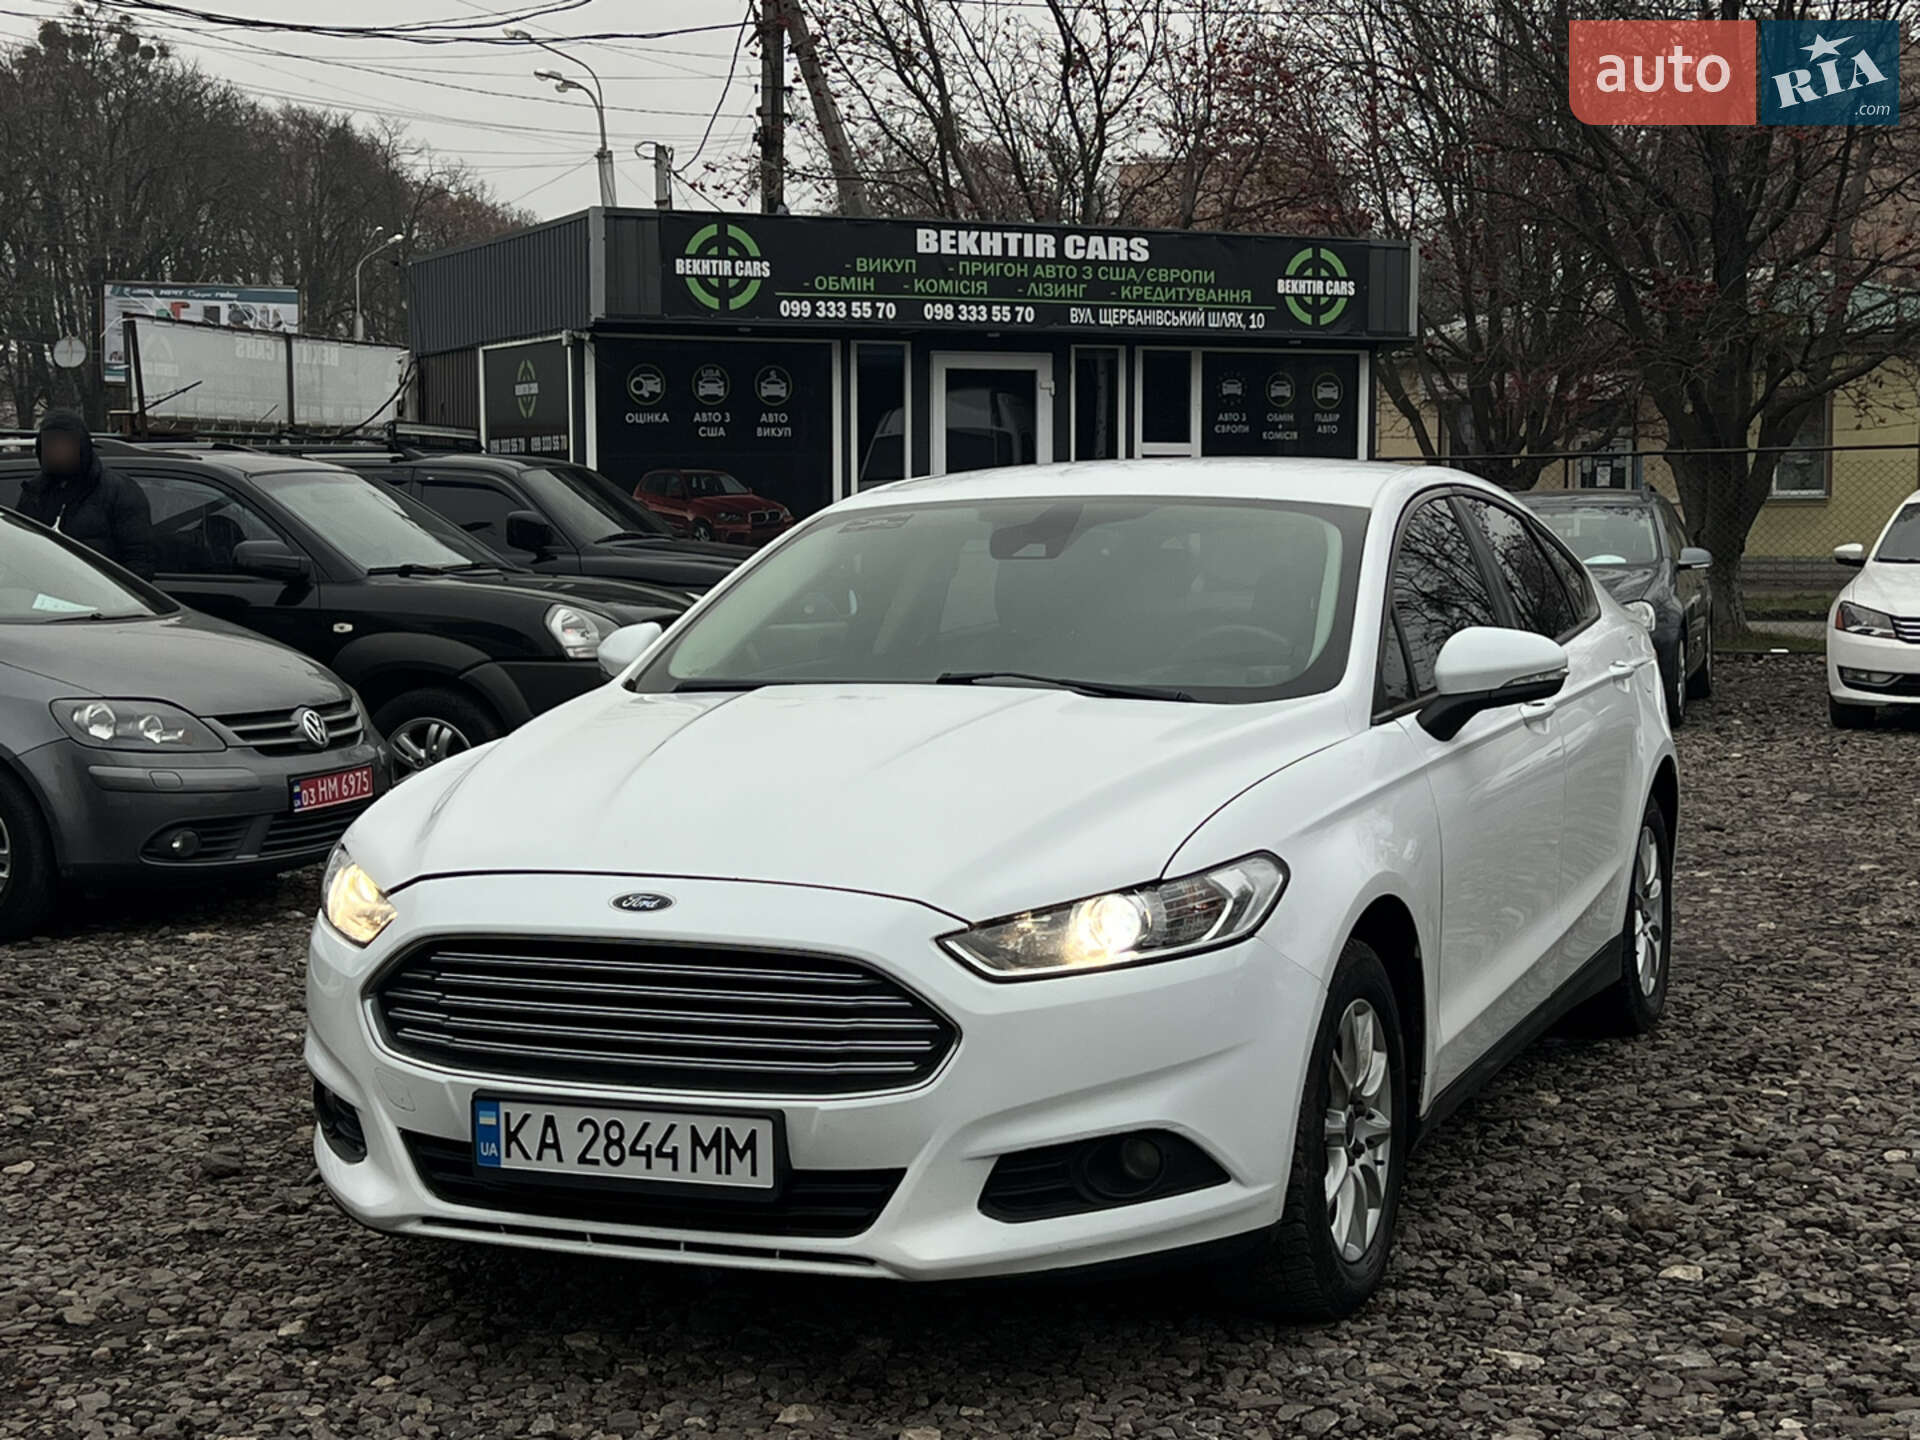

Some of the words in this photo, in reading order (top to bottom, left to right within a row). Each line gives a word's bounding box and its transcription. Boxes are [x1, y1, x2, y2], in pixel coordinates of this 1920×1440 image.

[916, 228, 1056, 258] BEKHTIR
[1064, 234, 1150, 262] CARS
[675, 258, 732, 276] BEKHTIR
[735, 260, 770, 278] CARS
[856, 257, 917, 273] ВИКУП
[959, 261, 1028, 277] ПРИГОН
[1033, 264, 1077, 279] АВТО
[814, 275, 875, 291] ОБМІН
[914, 279, 988, 295] КОМІСІЯ
[1027, 282, 1087, 298] ЛІЗИНГ
[1121, 286, 1252, 304] КРЕДИТУВАННЯ
[1277, 279, 1324, 295] BEKHTIR
[1325, 280, 1355, 296] CARS
[779, 300, 811, 317] 099
[815, 301, 847, 318] 333
[851, 302, 872, 319] 55
[875, 302, 896, 319] 70
[923, 303, 954, 320] 098
[958, 304, 988, 321] 333
[991, 305, 1011, 322] 55
[1014, 306, 1035, 323] 70
[1099, 306, 1205, 328] ЩЕРБАНІВСЬКИЙ
[1249, 312, 1266, 329] 10
[693, 412, 722, 423] АВТО
[760, 413, 788, 424] АВТО
[698, 426, 726, 437] США
[756, 427, 792, 438] ВИКУП
[301, 788, 316, 806] 03
[318, 777, 339, 802] HM
[341, 771, 369, 796] 6975
[622, 895, 661, 908] Ford
[480, 1142, 498, 1157] UA
[504, 1111, 564, 1163] KA
[577, 1118, 679, 1172] 2844
[690, 1123, 758, 1177] MM
